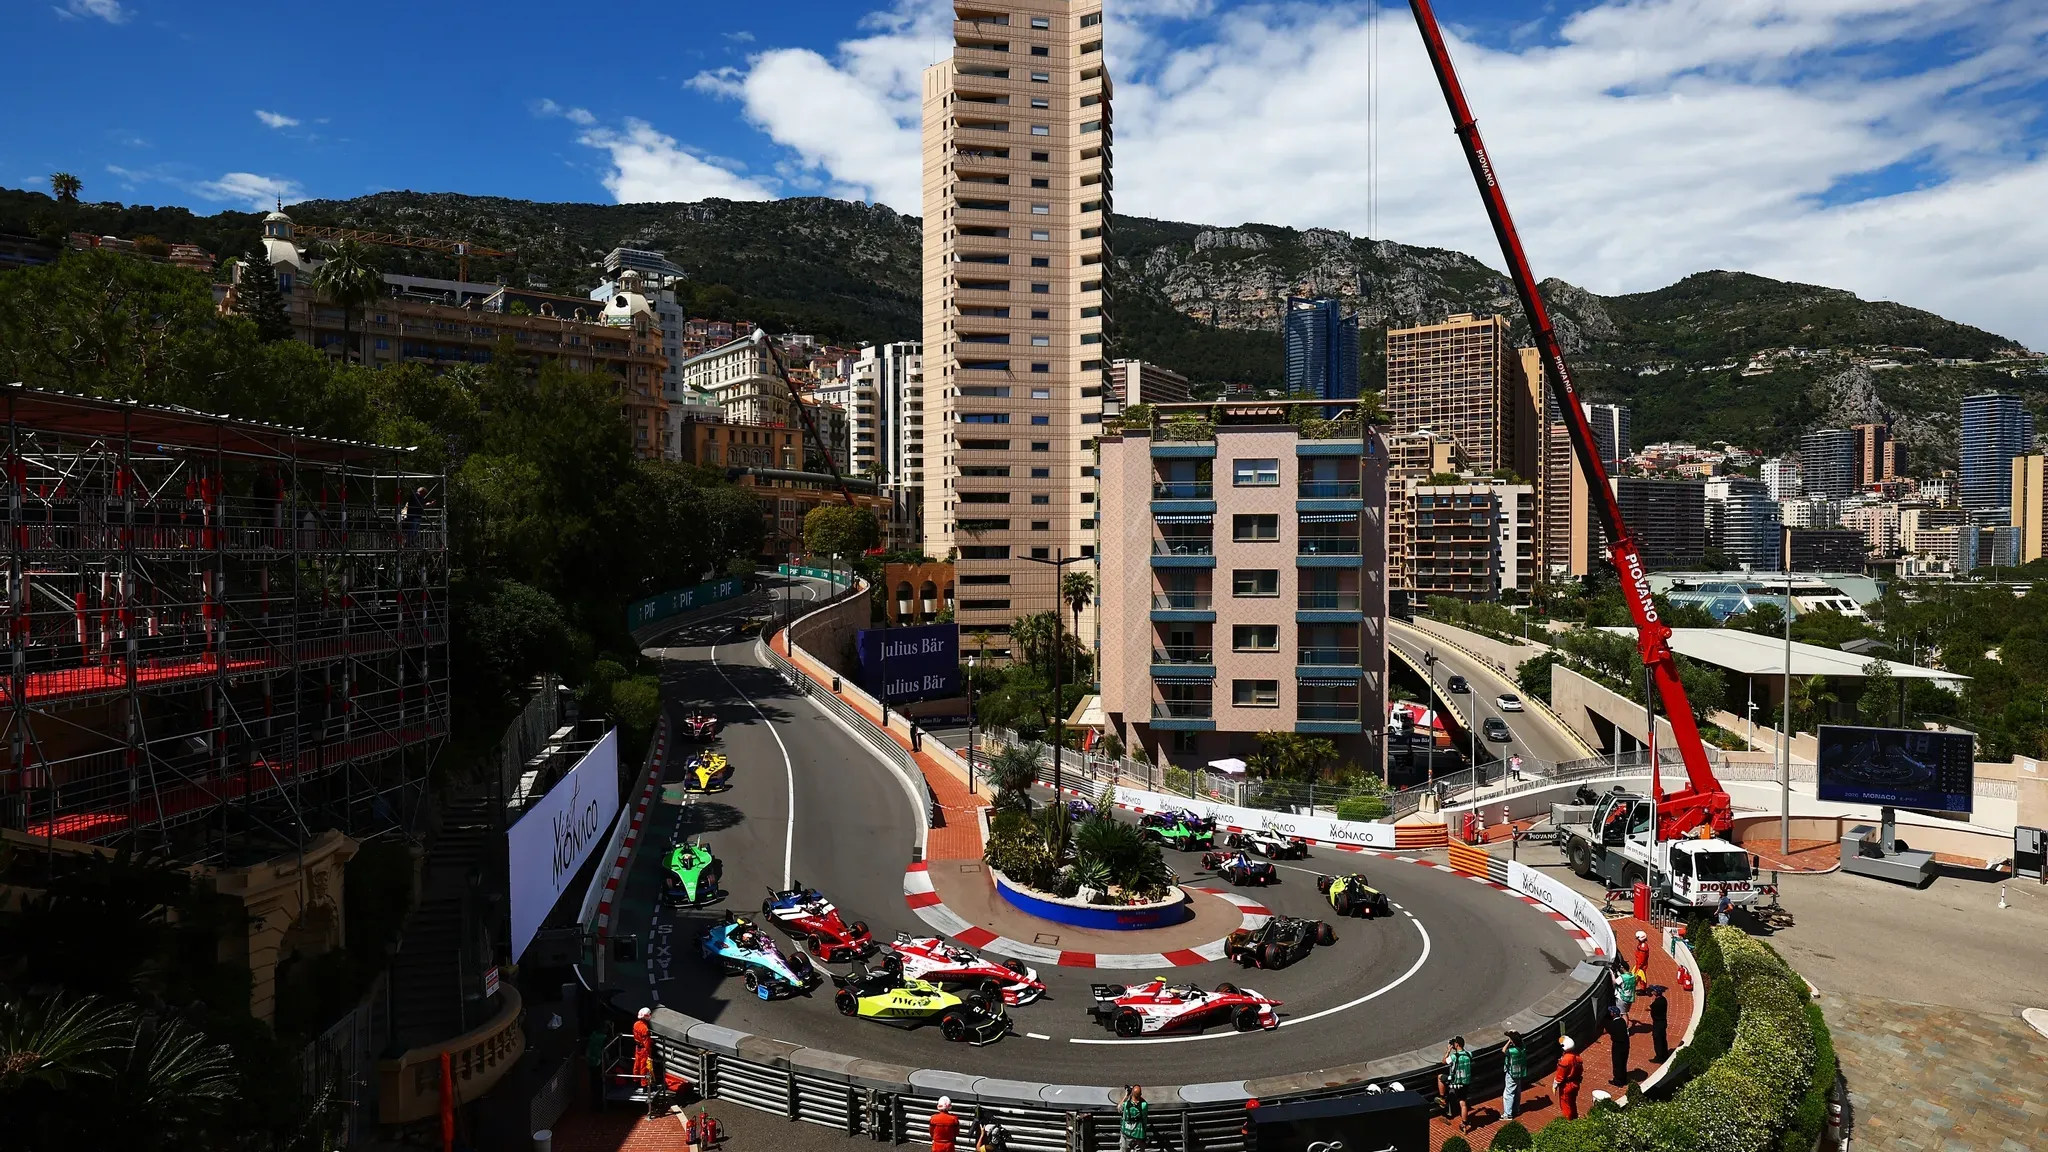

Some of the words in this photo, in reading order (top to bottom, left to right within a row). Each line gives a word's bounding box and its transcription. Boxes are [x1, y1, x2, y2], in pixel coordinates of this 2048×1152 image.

[1476, 149, 1495, 187] PIOVANO
[1554, 355, 1573, 393] PIOVANO
[680, 590, 694, 608] PIF
[720, 581, 733, 598] PIF
[1625, 553, 1658, 622] PIOVANO
[644, 601, 656, 621] PIF
[880, 640, 918, 661] Julius
[921, 638, 945, 654] Bär
[883, 678, 920, 699] ulius
[922, 675, 946, 691] Bär
[1862, 792, 1896, 801] MONACO
[553, 774, 581, 846] Visit
[1261, 822, 1296, 833] MONACO
[1329, 830, 1374, 842] MONACO
[1529, 832, 1558, 840] PIOVANO
[552, 799, 598, 892] MONACO
[1522, 880, 1553, 903] MONACO
[1700, 882, 1751, 891] PIOVANO
[1573, 908, 1596, 935] MONACO
[657, 924, 675, 981] TAXIS
[1171, 1010, 1208, 1023] NISSAN
